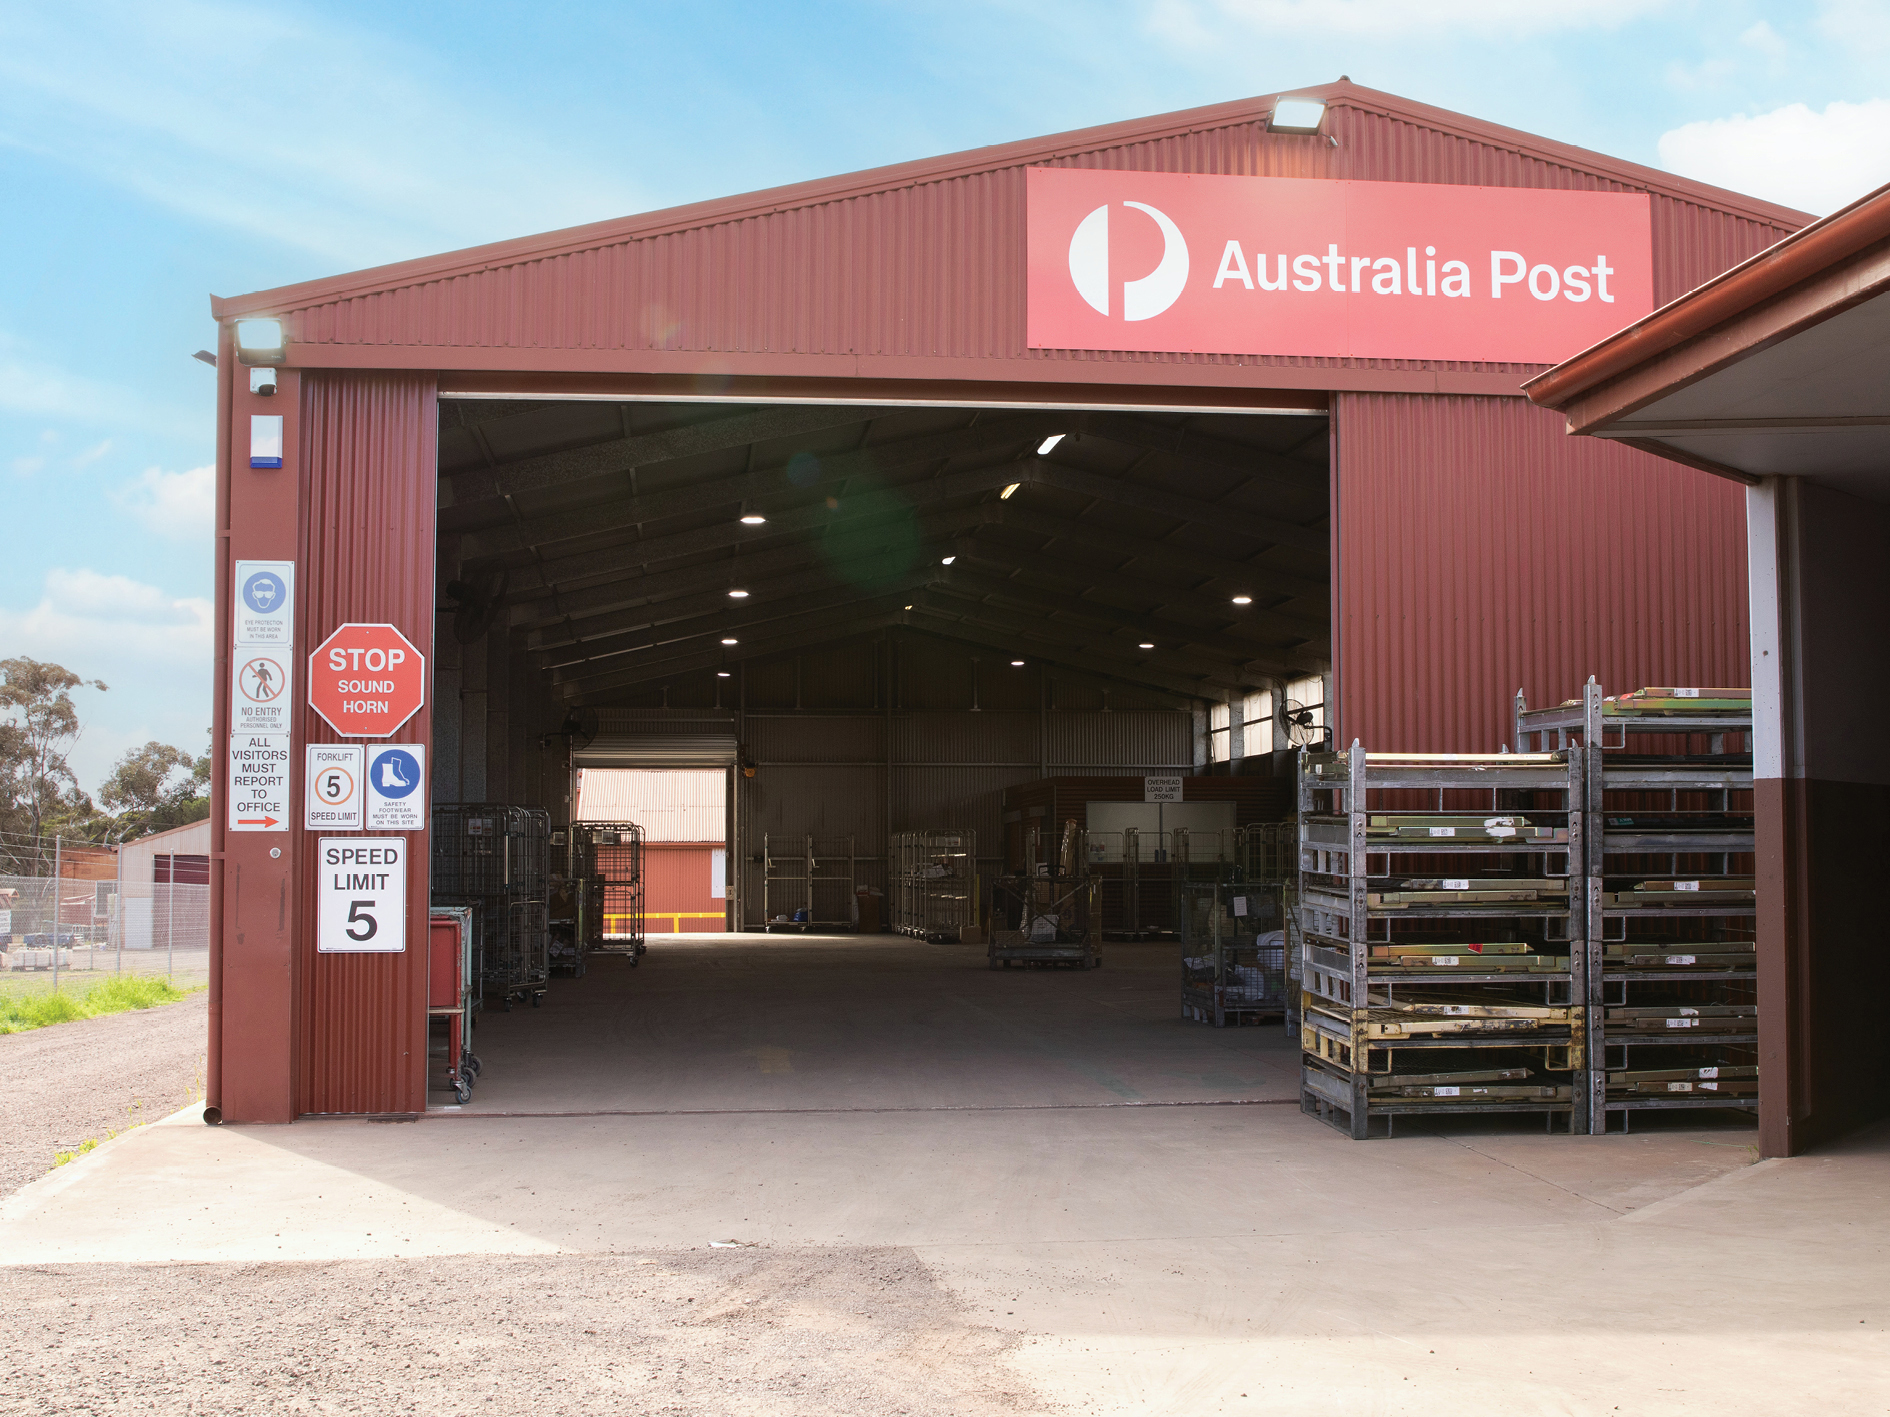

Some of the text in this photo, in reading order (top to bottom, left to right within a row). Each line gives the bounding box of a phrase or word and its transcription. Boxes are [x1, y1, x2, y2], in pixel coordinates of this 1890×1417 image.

[1213, 240, 1615, 304] Australia Post
[328, 648, 405, 672] STOP
[338, 680, 395, 693] SOUND
[242, 707, 282, 716] NO ENTRY
[343, 701, 388, 714] HORN
[249, 738, 270, 747] ALL
[232, 750, 288, 760] VISITORS
[317, 753, 353, 761] FORKLIFT
[242, 764, 276, 773] MUST
[234, 776, 283, 786] REPORT
[326, 776, 340, 798] 5
[251, 789, 267, 798] TO
[237, 802, 280, 812] OFFICE
[311, 812, 336, 820] SPEED
[326, 848, 398, 866] SPEED
[334, 874, 390, 890] LIMIT
[346, 900, 378, 942] 5
